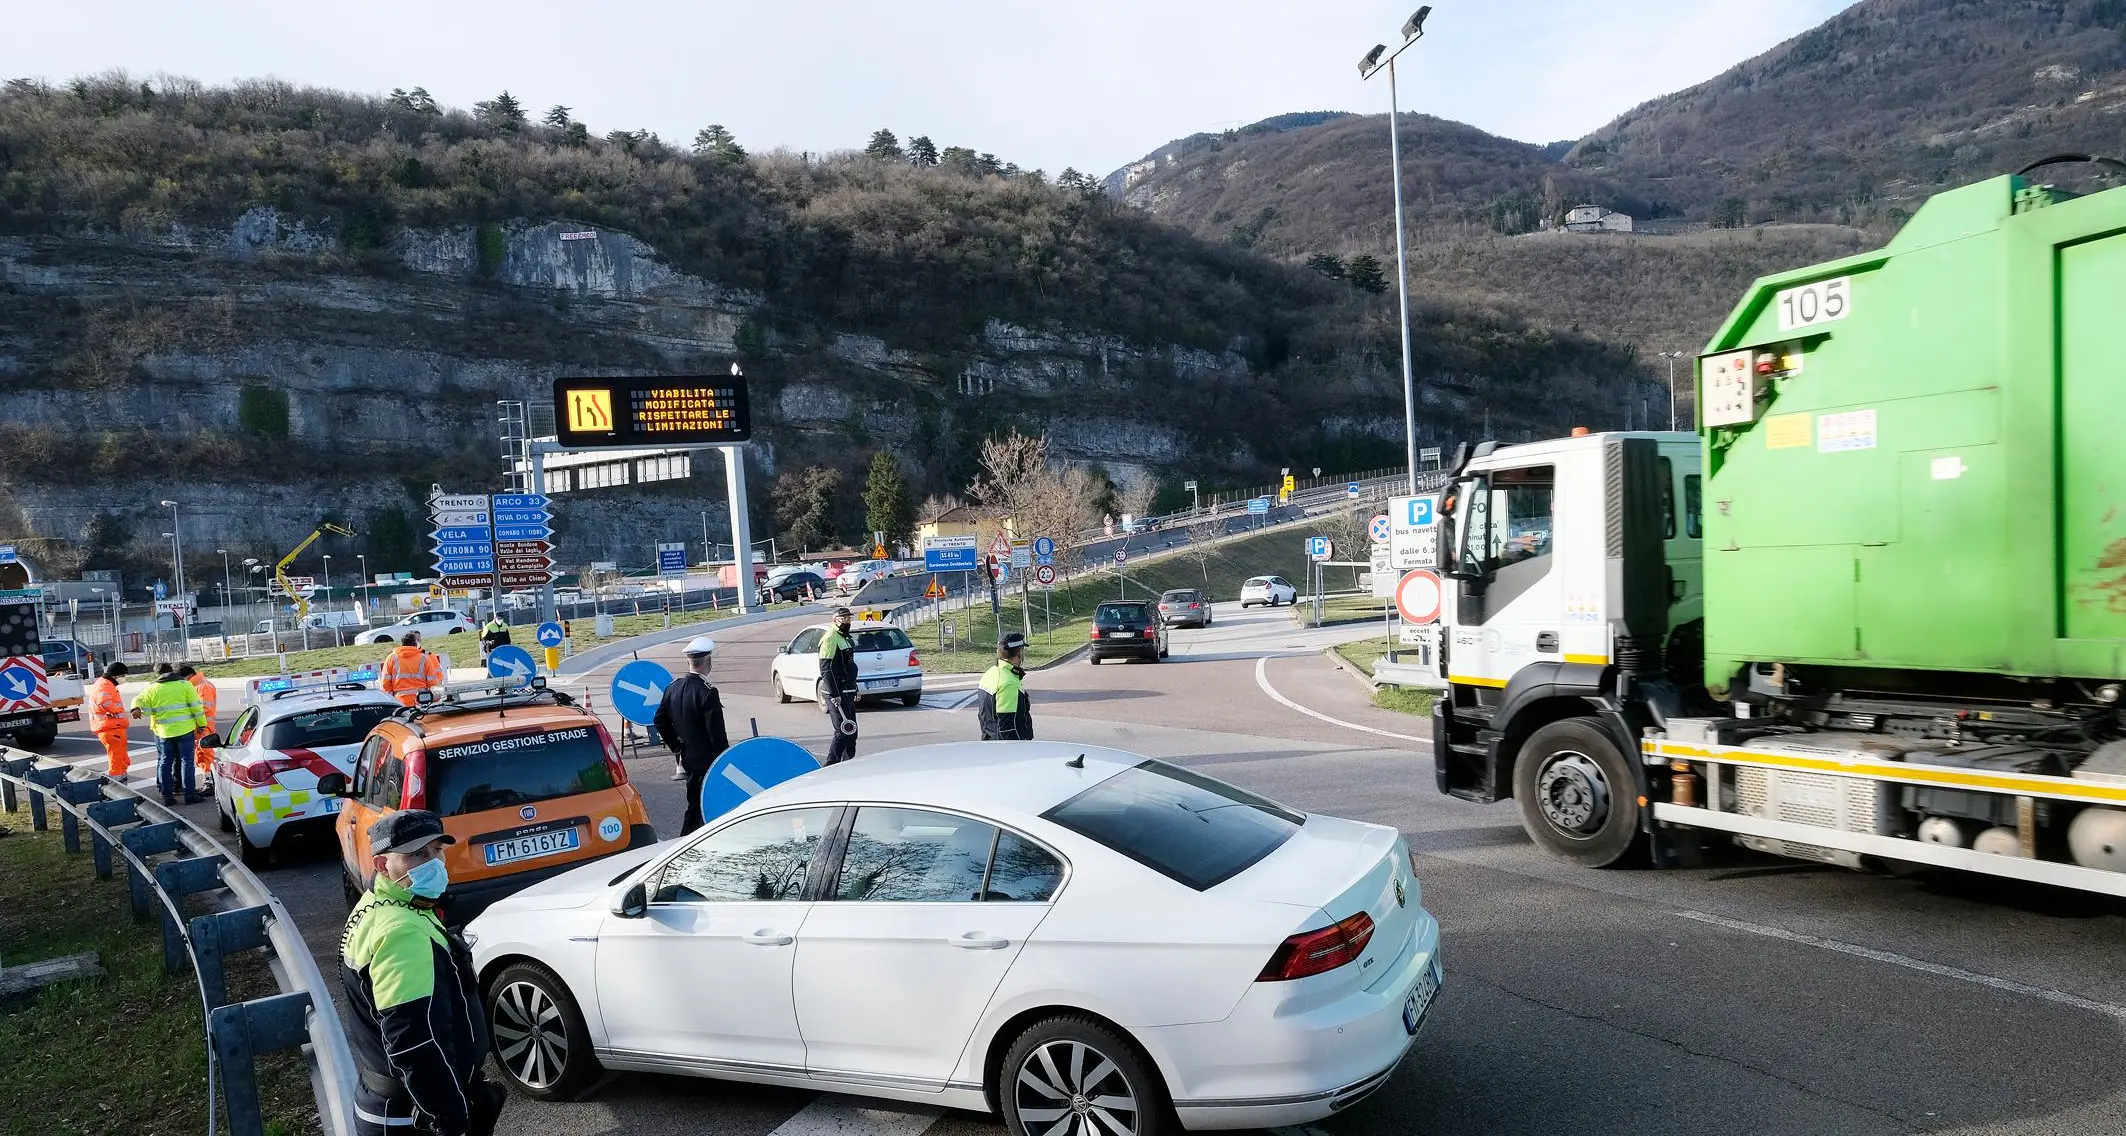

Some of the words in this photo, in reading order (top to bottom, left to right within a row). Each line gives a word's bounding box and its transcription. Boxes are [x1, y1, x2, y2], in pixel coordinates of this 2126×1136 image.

[1784, 281, 1843, 325] 105
[652, 389, 714, 398] VIABILITA
[645, 400, 715, 409] MODIFICATA
[639, 411, 709, 421] RISPETTARE
[715, 410, 729, 419] LE
[647, 421, 723, 431] LIMITAZIONI
[440, 499, 474, 507] TRENTO
[496, 498, 521, 506] ARCO
[497, 513, 514, 521] RIVA
[1413, 502, 1428, 523] P
[442, 531, 467, 539] VELA
[1413, 526, 1437, 534] navett
[443, 546, 475, 555] VERONA
[479, 545, 489, 554] 90
[1400, 547, 1419, 555] dalle
[1422, 546, 1437, 554] 6.3
[443, 562, 473, 571] PADOVA
[477, 561, 490, 569] 135
[445, 576, 492, 587] Valsugana
[292, 713, 318, 721] POLIZIA
[318, 709, 344, 717] LOCALE
[438, 743, 490, 760] SERVIZIO
[492, 734, 546, 751] GESTIONE
[548, 728, 588, 743] STRADE
[516, 825, 548, 836] panda
[601, 823, 620, 835] 100
[496, 841, 516, 859] FM
[521, 833, 568, 854] 616YZ
